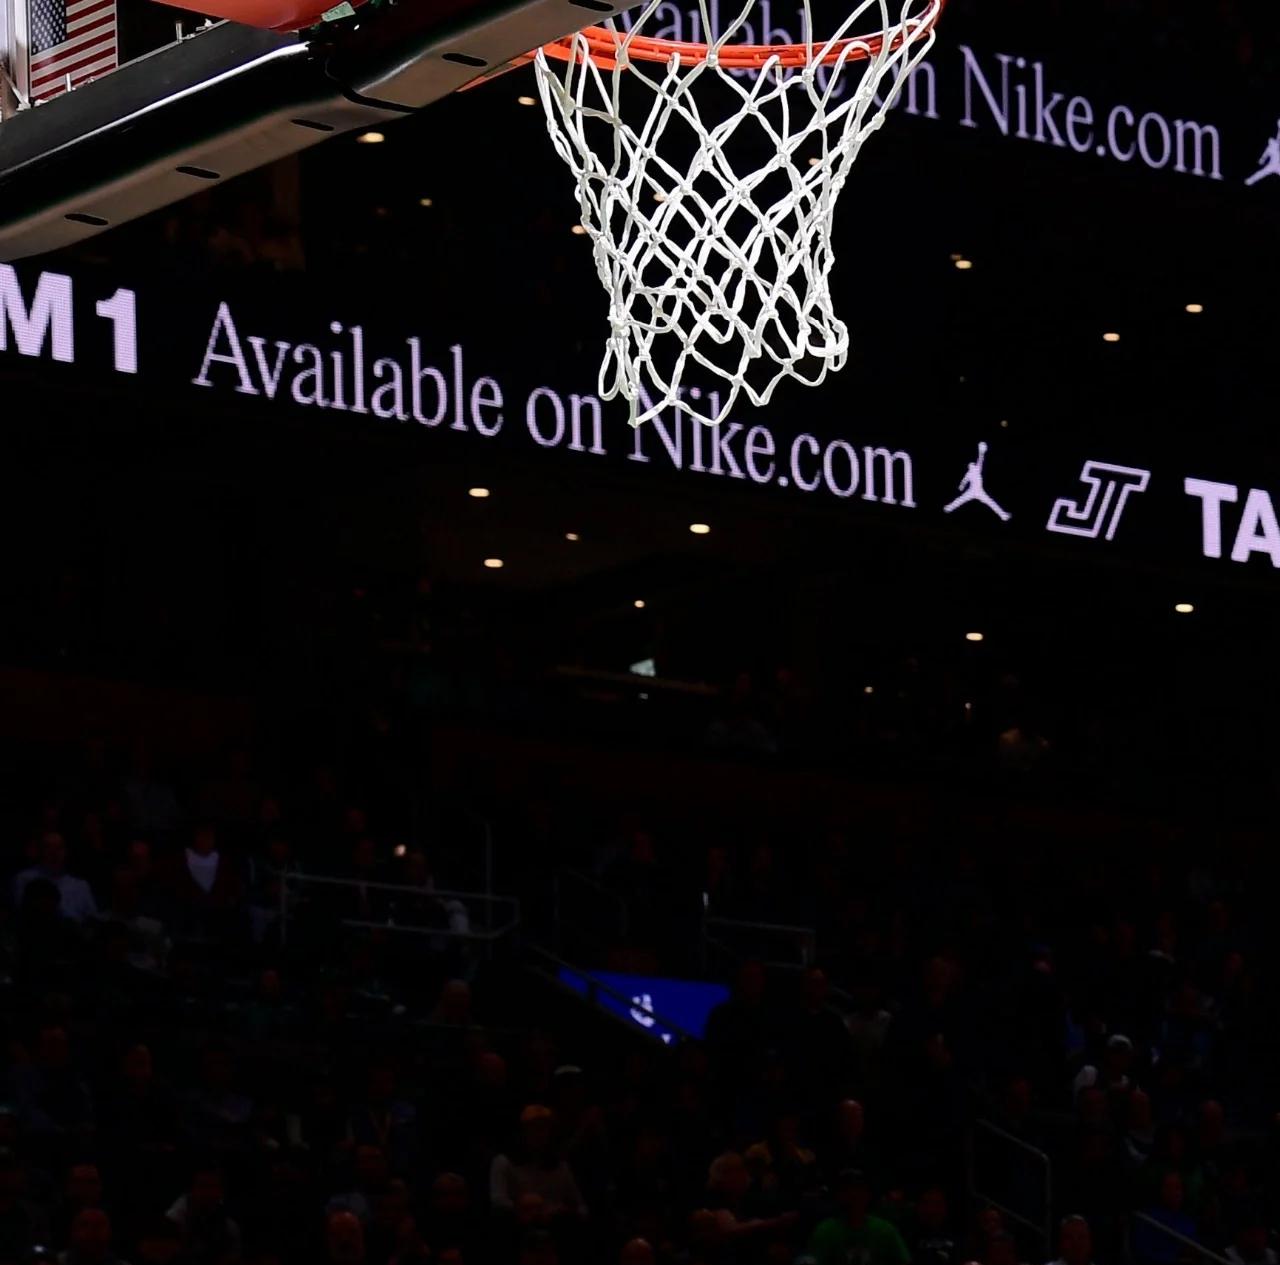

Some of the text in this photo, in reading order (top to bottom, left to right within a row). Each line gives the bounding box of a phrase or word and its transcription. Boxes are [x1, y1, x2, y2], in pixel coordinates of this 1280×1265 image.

[960, 46, 1223, 180] Nike.com
[96, 288, 138, 374] 1
[193, 301, 504, 437] Available
[527, 386, 607, 456] on
[628, 378, 917, 509] Nike.com
